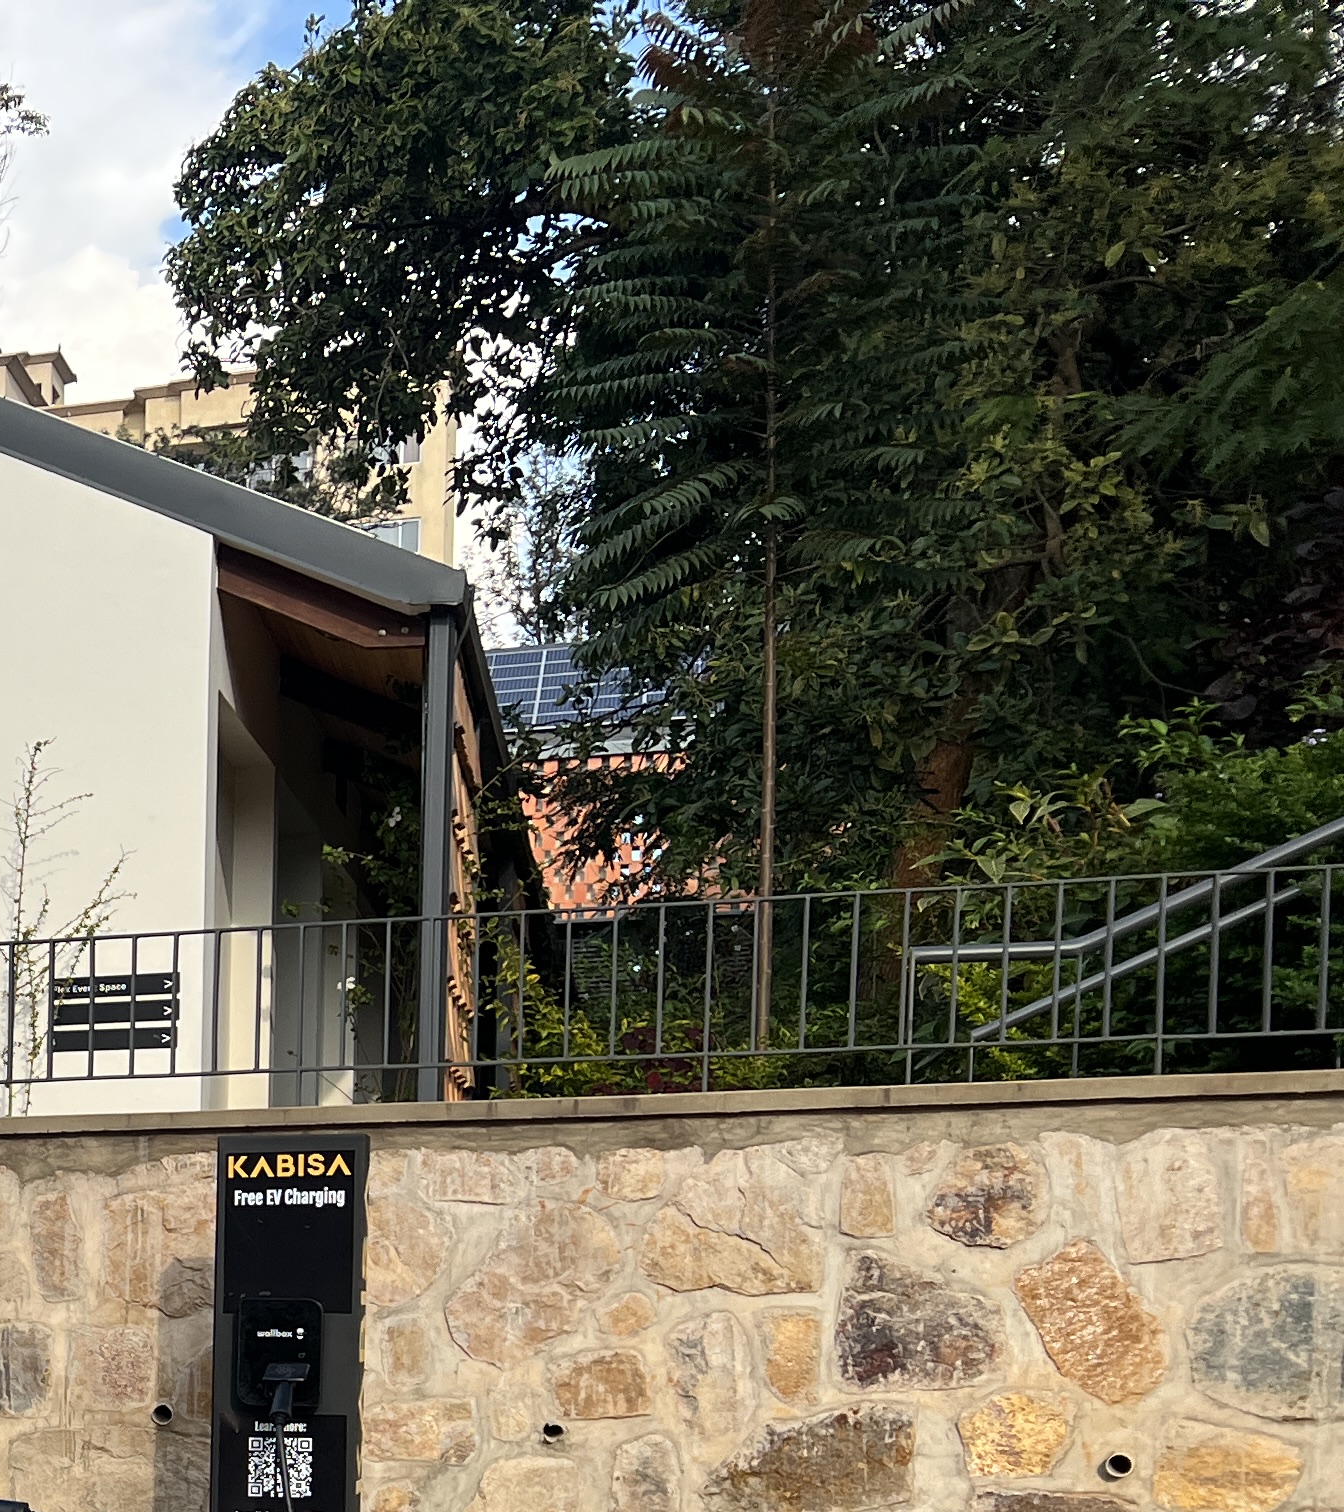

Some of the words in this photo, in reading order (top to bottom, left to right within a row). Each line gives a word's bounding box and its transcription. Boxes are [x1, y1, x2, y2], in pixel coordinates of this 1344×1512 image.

[99, 983, 127, 993] Space
[228, 1153, 352, 1178] KABISA
[234, 1190, 264, 1206] Free
[266, 1189, 283, 1206] EV
[285, 1186, 346, 1208] Charging
[257, 1328, 293, 1338] wallbox
[254, 1420, 277, 1432] Lear
